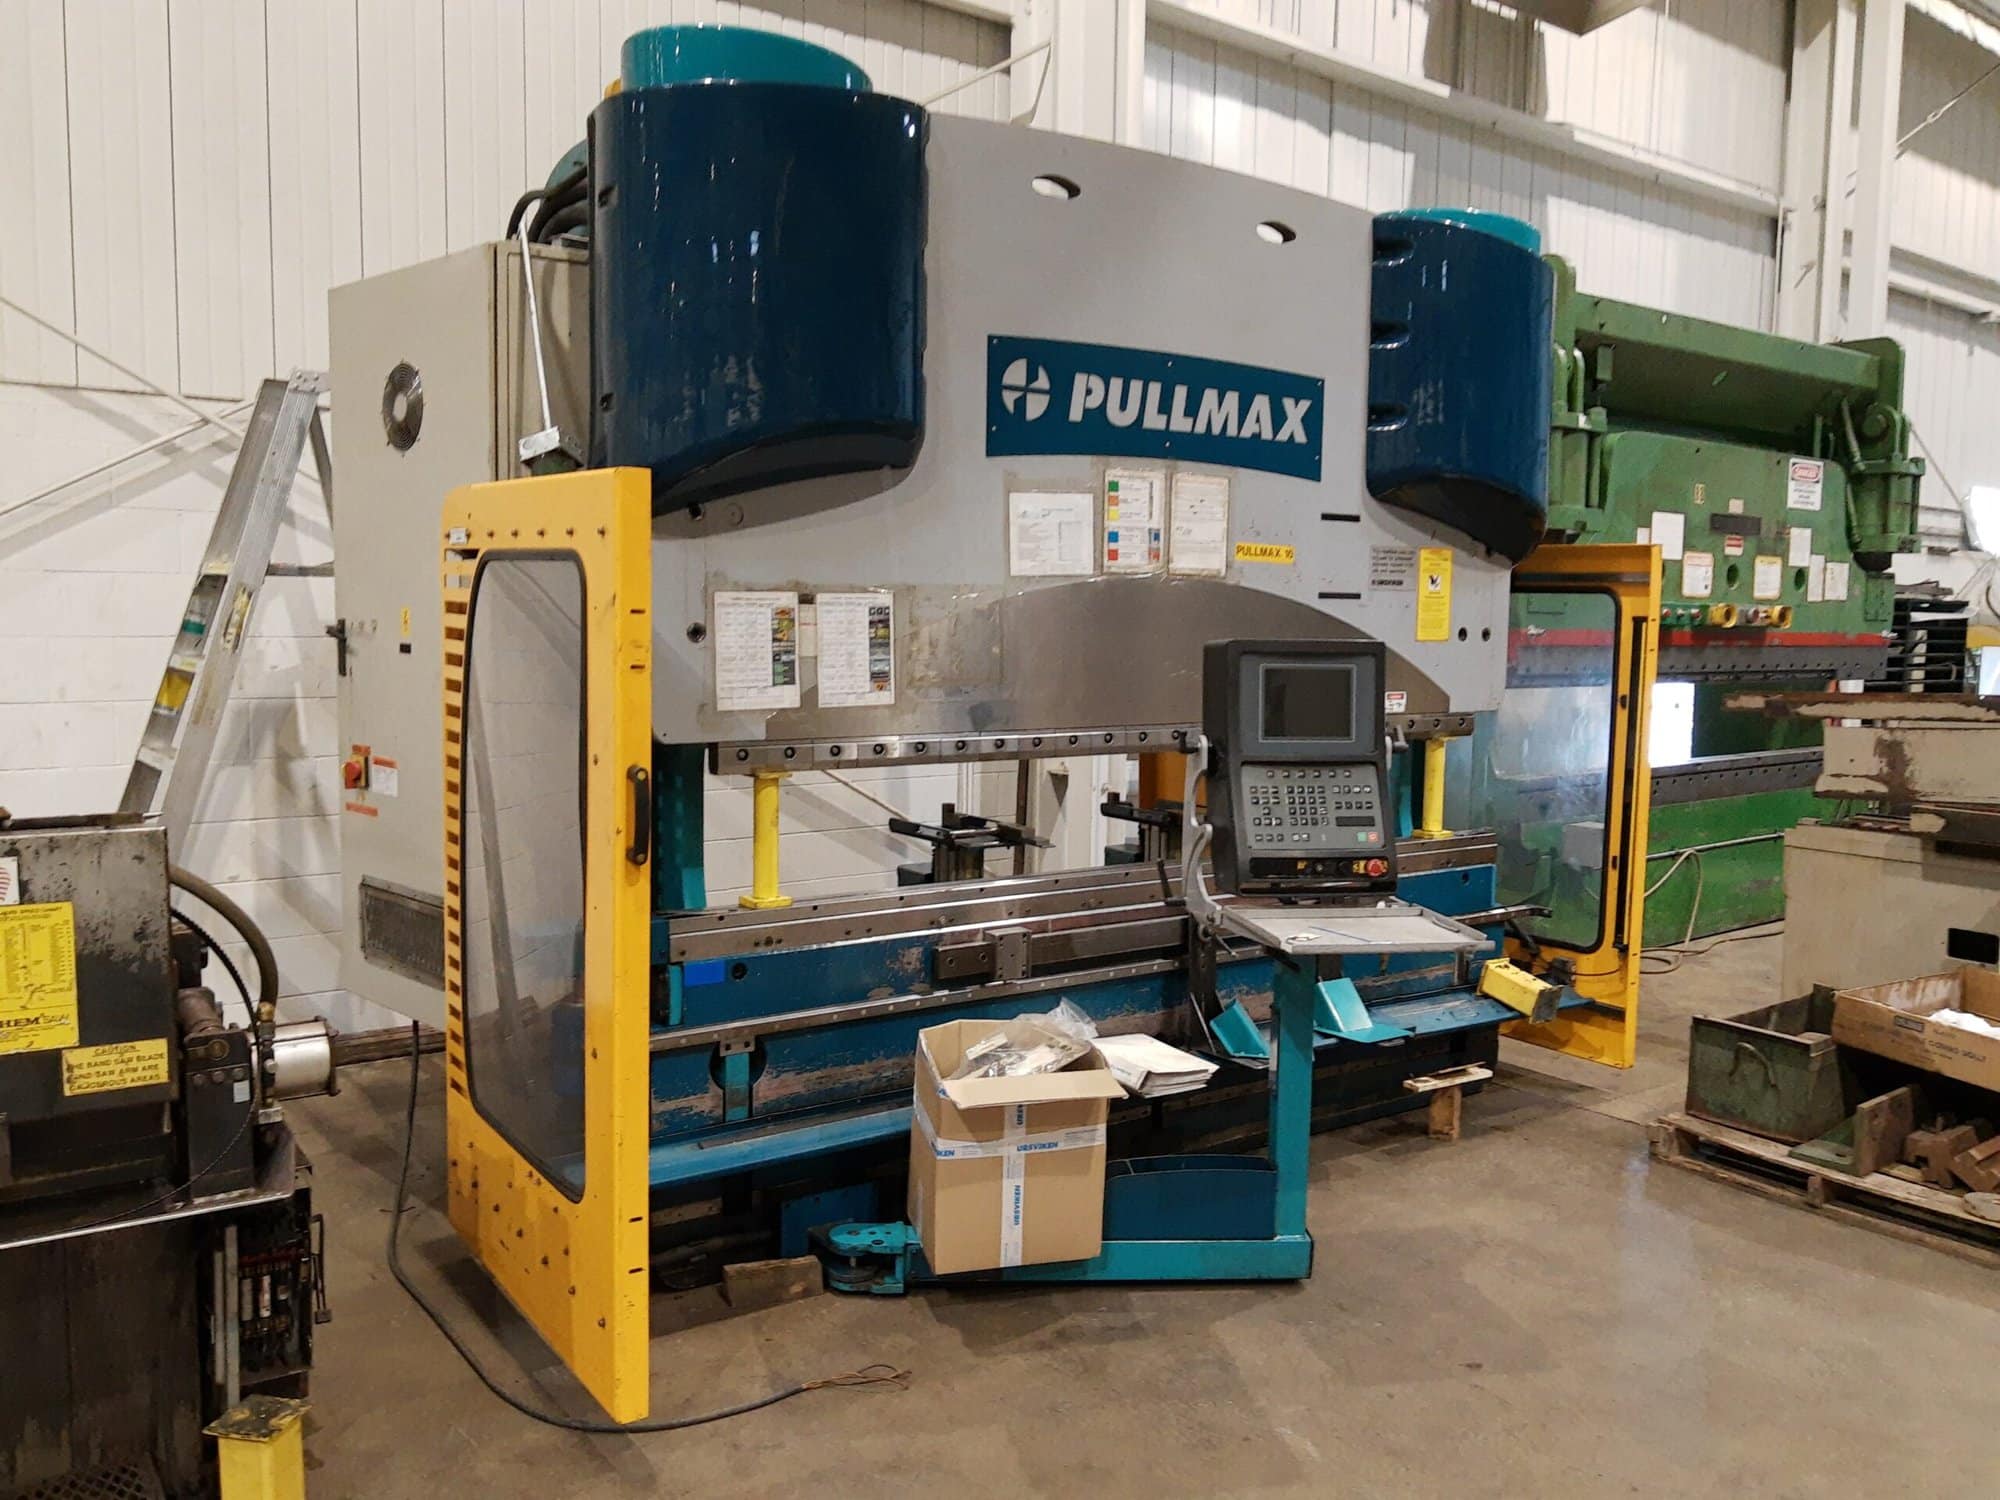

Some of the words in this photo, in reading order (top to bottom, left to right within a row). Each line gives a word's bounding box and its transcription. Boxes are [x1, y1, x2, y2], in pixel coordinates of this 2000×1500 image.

[1068, 371, 1313, 445] PULLMAX
[1236, 545, 1281, 558] PULLMAX
[94, 1045, 137, 1056] CAUTION
[1016, 1141, 1059, 1152] URSVIKEN
